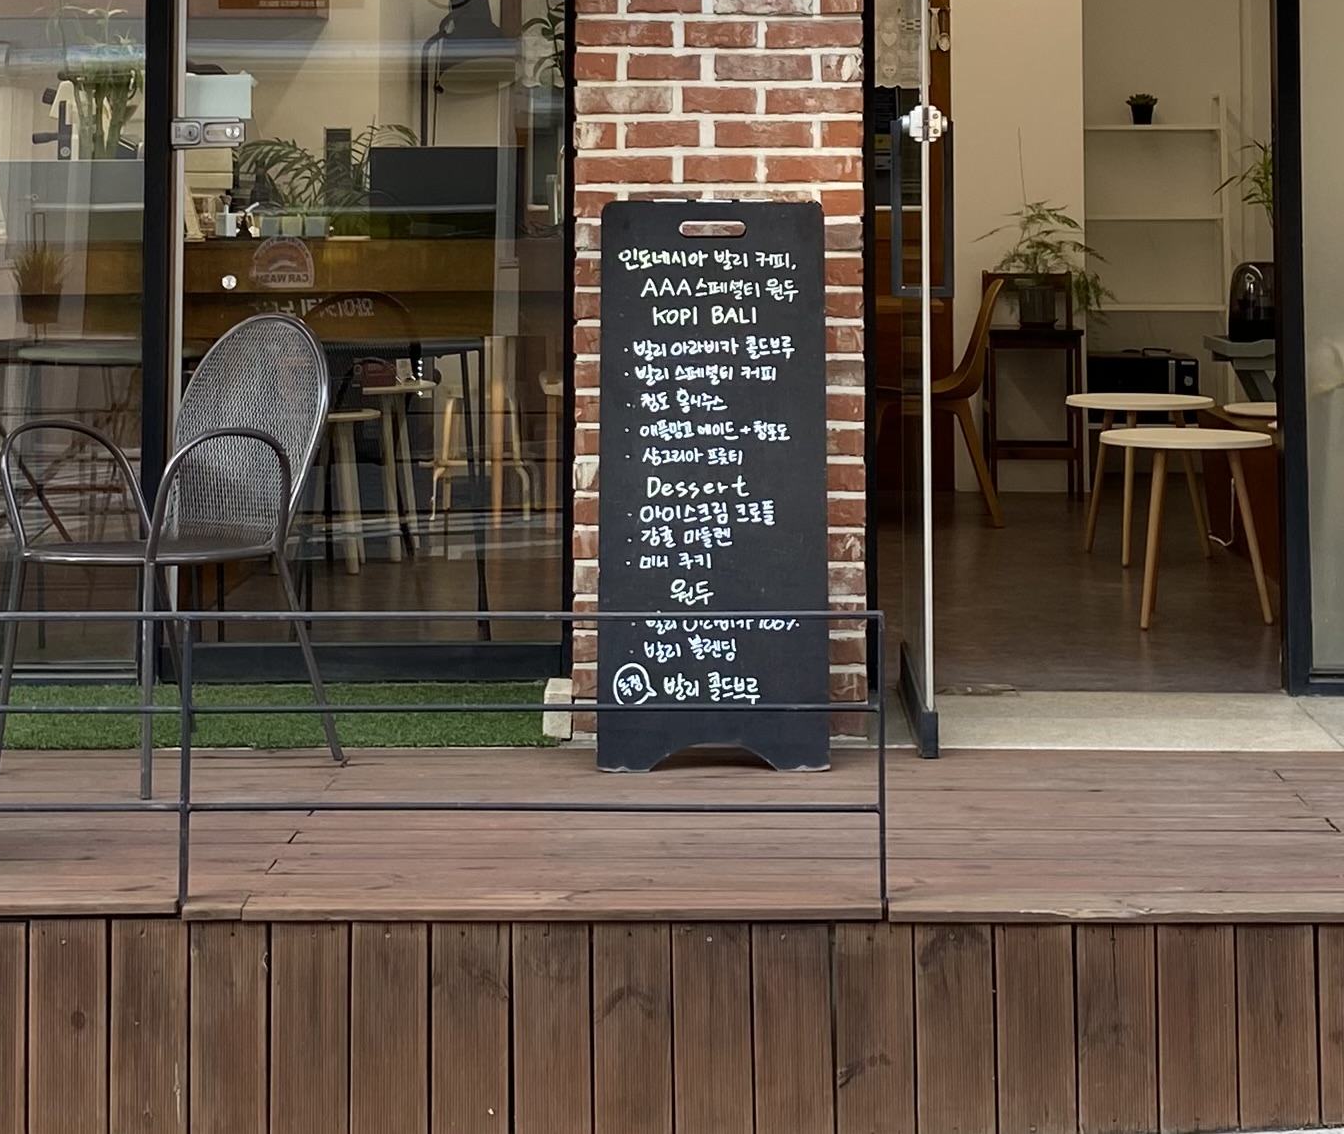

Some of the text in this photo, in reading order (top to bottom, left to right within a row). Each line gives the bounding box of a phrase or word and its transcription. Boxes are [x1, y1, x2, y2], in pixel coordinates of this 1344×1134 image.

[618, 248, 797, 271] 인도네시아 발리 커피,
[765, 278, 799, 302] 원두
[652, 305, 757, 326] KOPI BALI
[633, 335, 795, 361] 발리 아라비카 콜드브루
[635, 364, 669, 386] 발리
[740, 366, 777, 382] 커피
[676, 387, 728, 413] 홍시주스
[639, 419, 695, 442] 애플망고
[697, 421, 739, 441] 에이드
[646, 474, 750, 499] Dessert
[639, 499, 776, 526] 아이스크림 크로플
[683, 526, 733, 548] 마들렌
[639, 552, 712, 570] 미니 쿠키
[669, 578, 714, 606] 원두
[643, 634, 737, 663] 발리 블렌딩
[663, 672, 700, 701] 발리
[707, 671, 761, 705] 콜드브루
